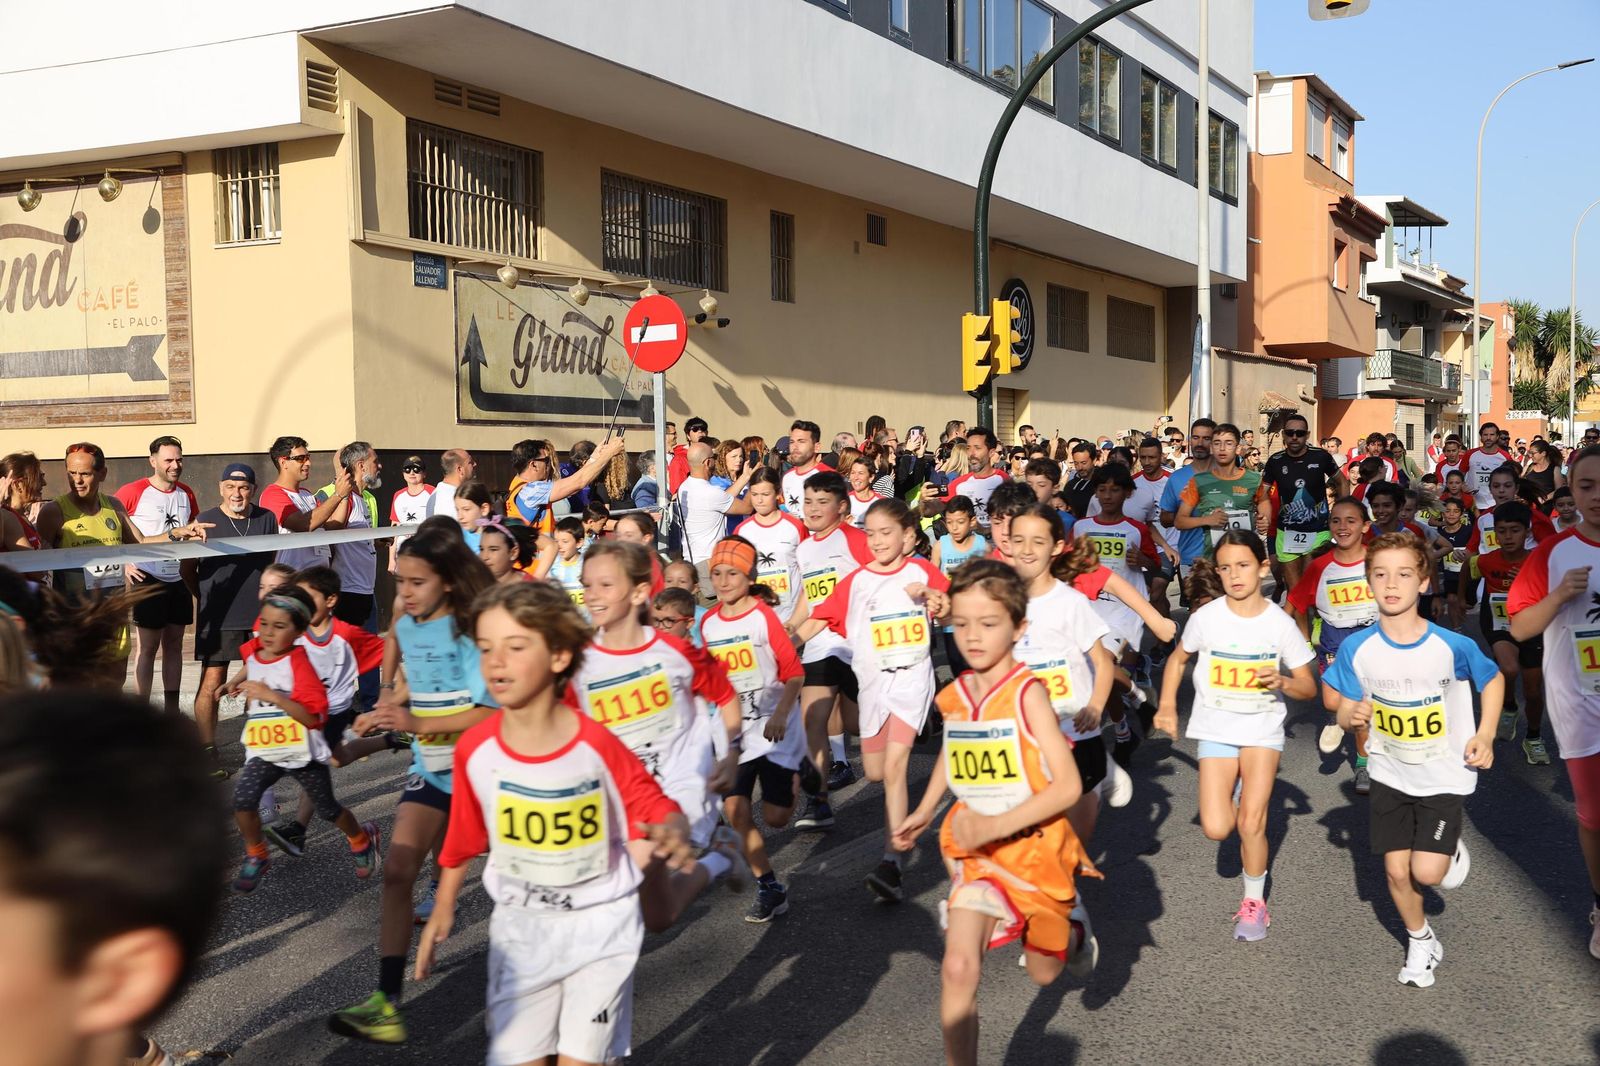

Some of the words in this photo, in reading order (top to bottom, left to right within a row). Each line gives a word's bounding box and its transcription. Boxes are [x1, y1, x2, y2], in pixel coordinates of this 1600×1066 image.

[415, 265, 441, 276] SALVADOR
[416, 275, 438, 286] ALLENDE
[77, 280, 140, 313] CAFÉ
[497, 300, 516, 321] LE
[510, 311, 614, 388] Grand
[1094, 541, 1124, 557] 039
[1294, 533, 1307, 543] 42
[874, 622, 925, 647] 1119
[1212, 665, 1260, 690] 112
[594, 681, 670, 724] 1116
[247, 722, 304, 747] 1081
[1376, 709, 1442, 738] 1016
[951, 749, 1017, 780] 1041
[502, 803, 599, 846] 1058
